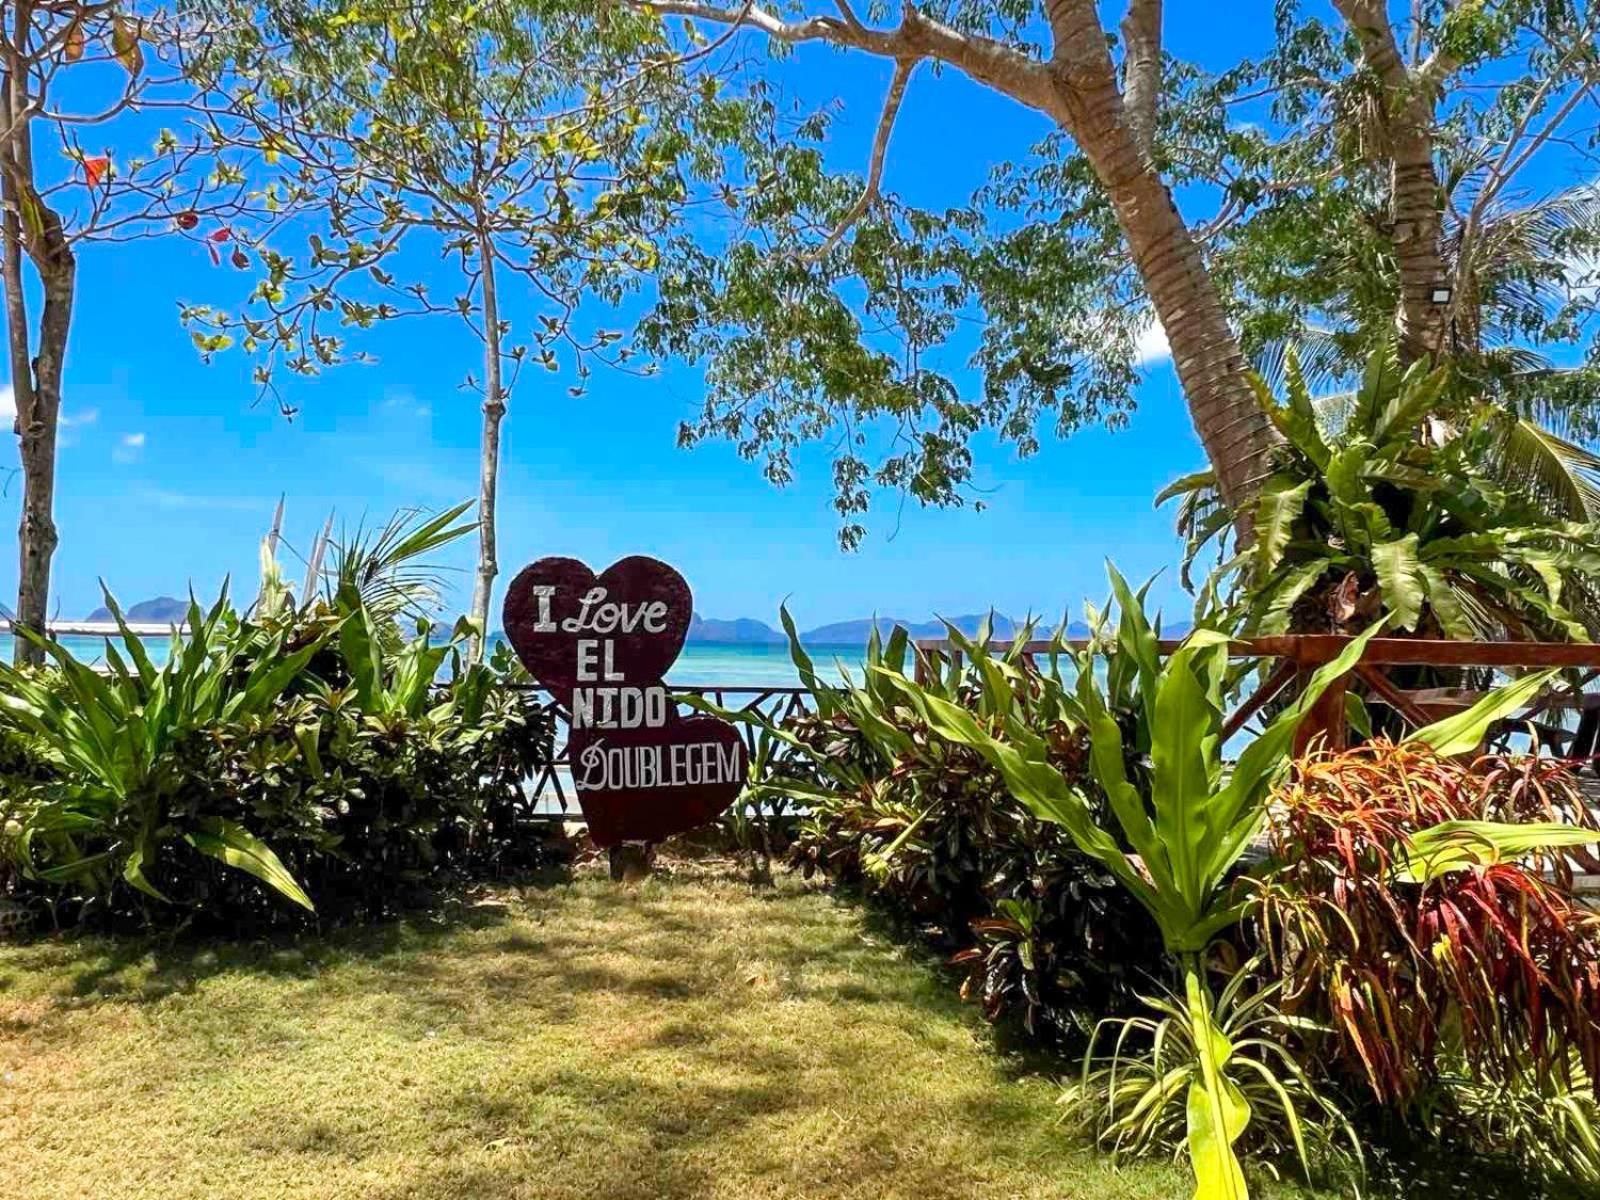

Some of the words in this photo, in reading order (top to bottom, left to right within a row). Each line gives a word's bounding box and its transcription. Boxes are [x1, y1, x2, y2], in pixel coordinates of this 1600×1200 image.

[533, 585, 557, 633] I
[562, 586, 669, 634] Love
[576, 640, 625, 682] EL
[572, 686, 666, 729] NIDO
